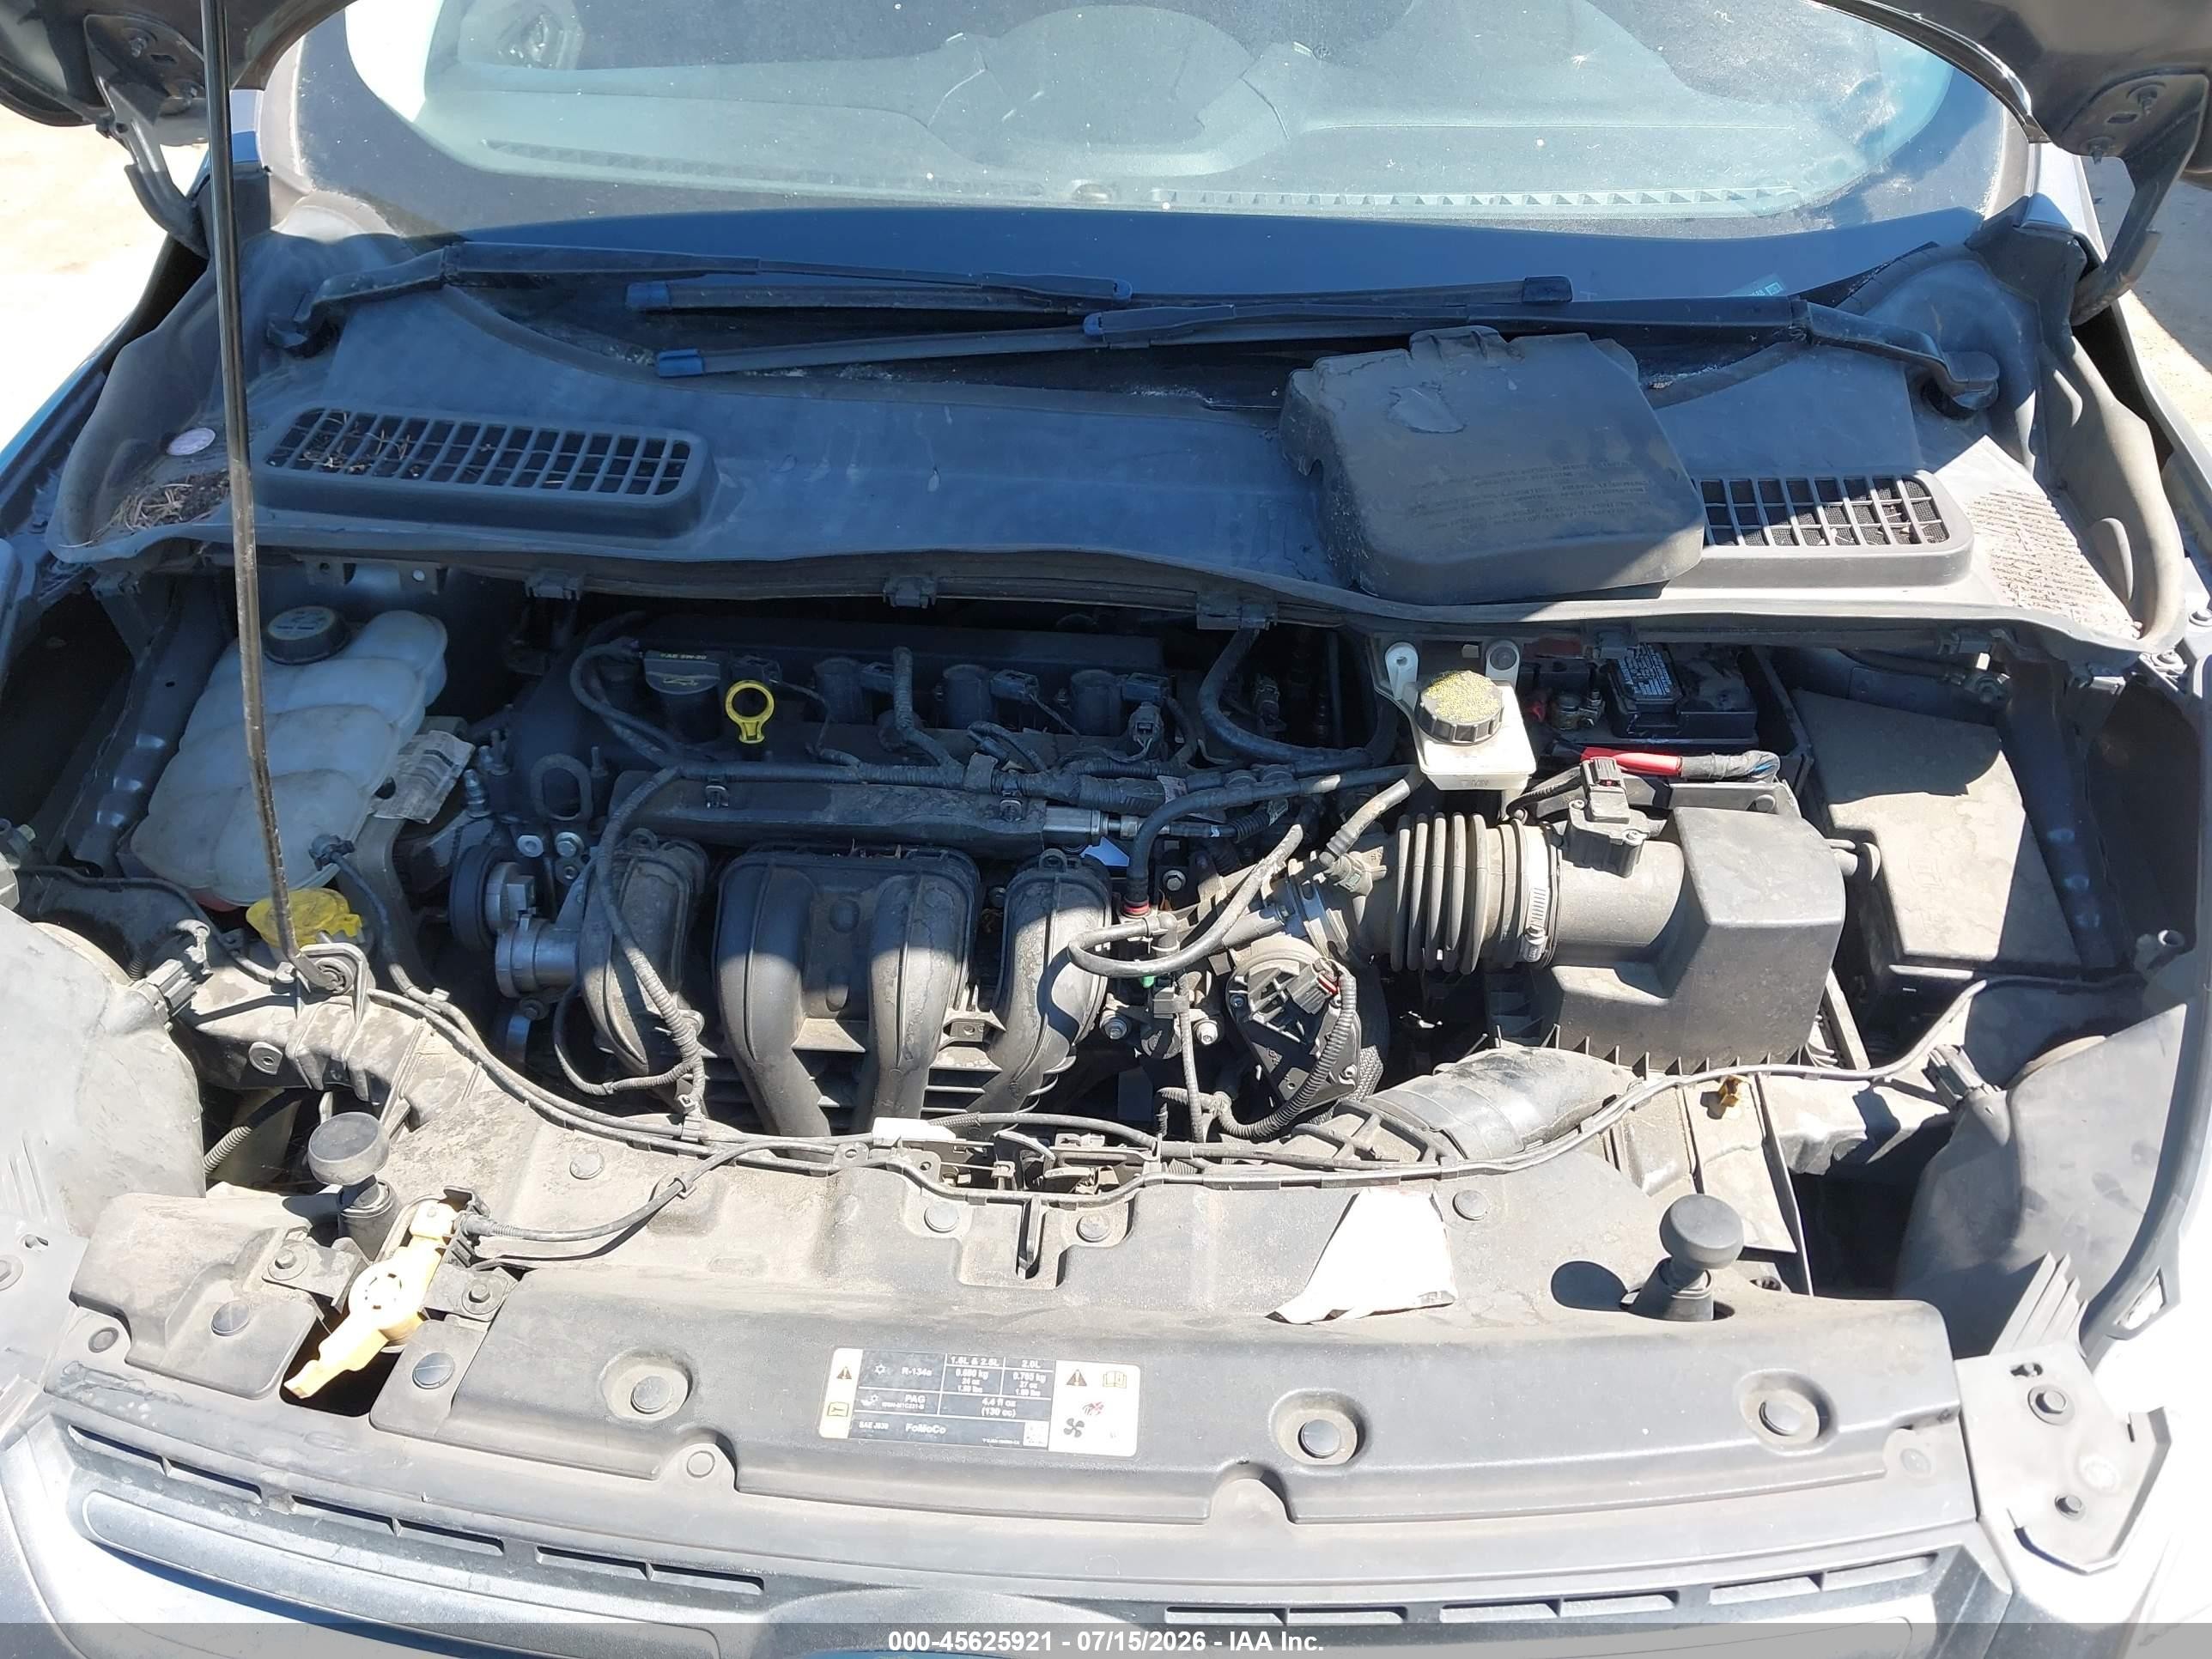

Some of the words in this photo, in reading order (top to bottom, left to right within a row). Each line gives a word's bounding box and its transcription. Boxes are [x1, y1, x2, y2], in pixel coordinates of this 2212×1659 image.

[1021, 1359, 1041, 1369] 2.0L
[901, 1366, 933, 1376] R-134a
[978, 1369, 989, 1380] kg
[1036, 1372, 1047, 1384] kg
[904, 1394, 926, 1404] PAG
[981, 1397, 995, 1406] 4.4
[981, 1407, 1001, 1417] (130
[859, 1420, 873, 1429] SAE
[905, 1422, 946, 1435] FoMoCo
